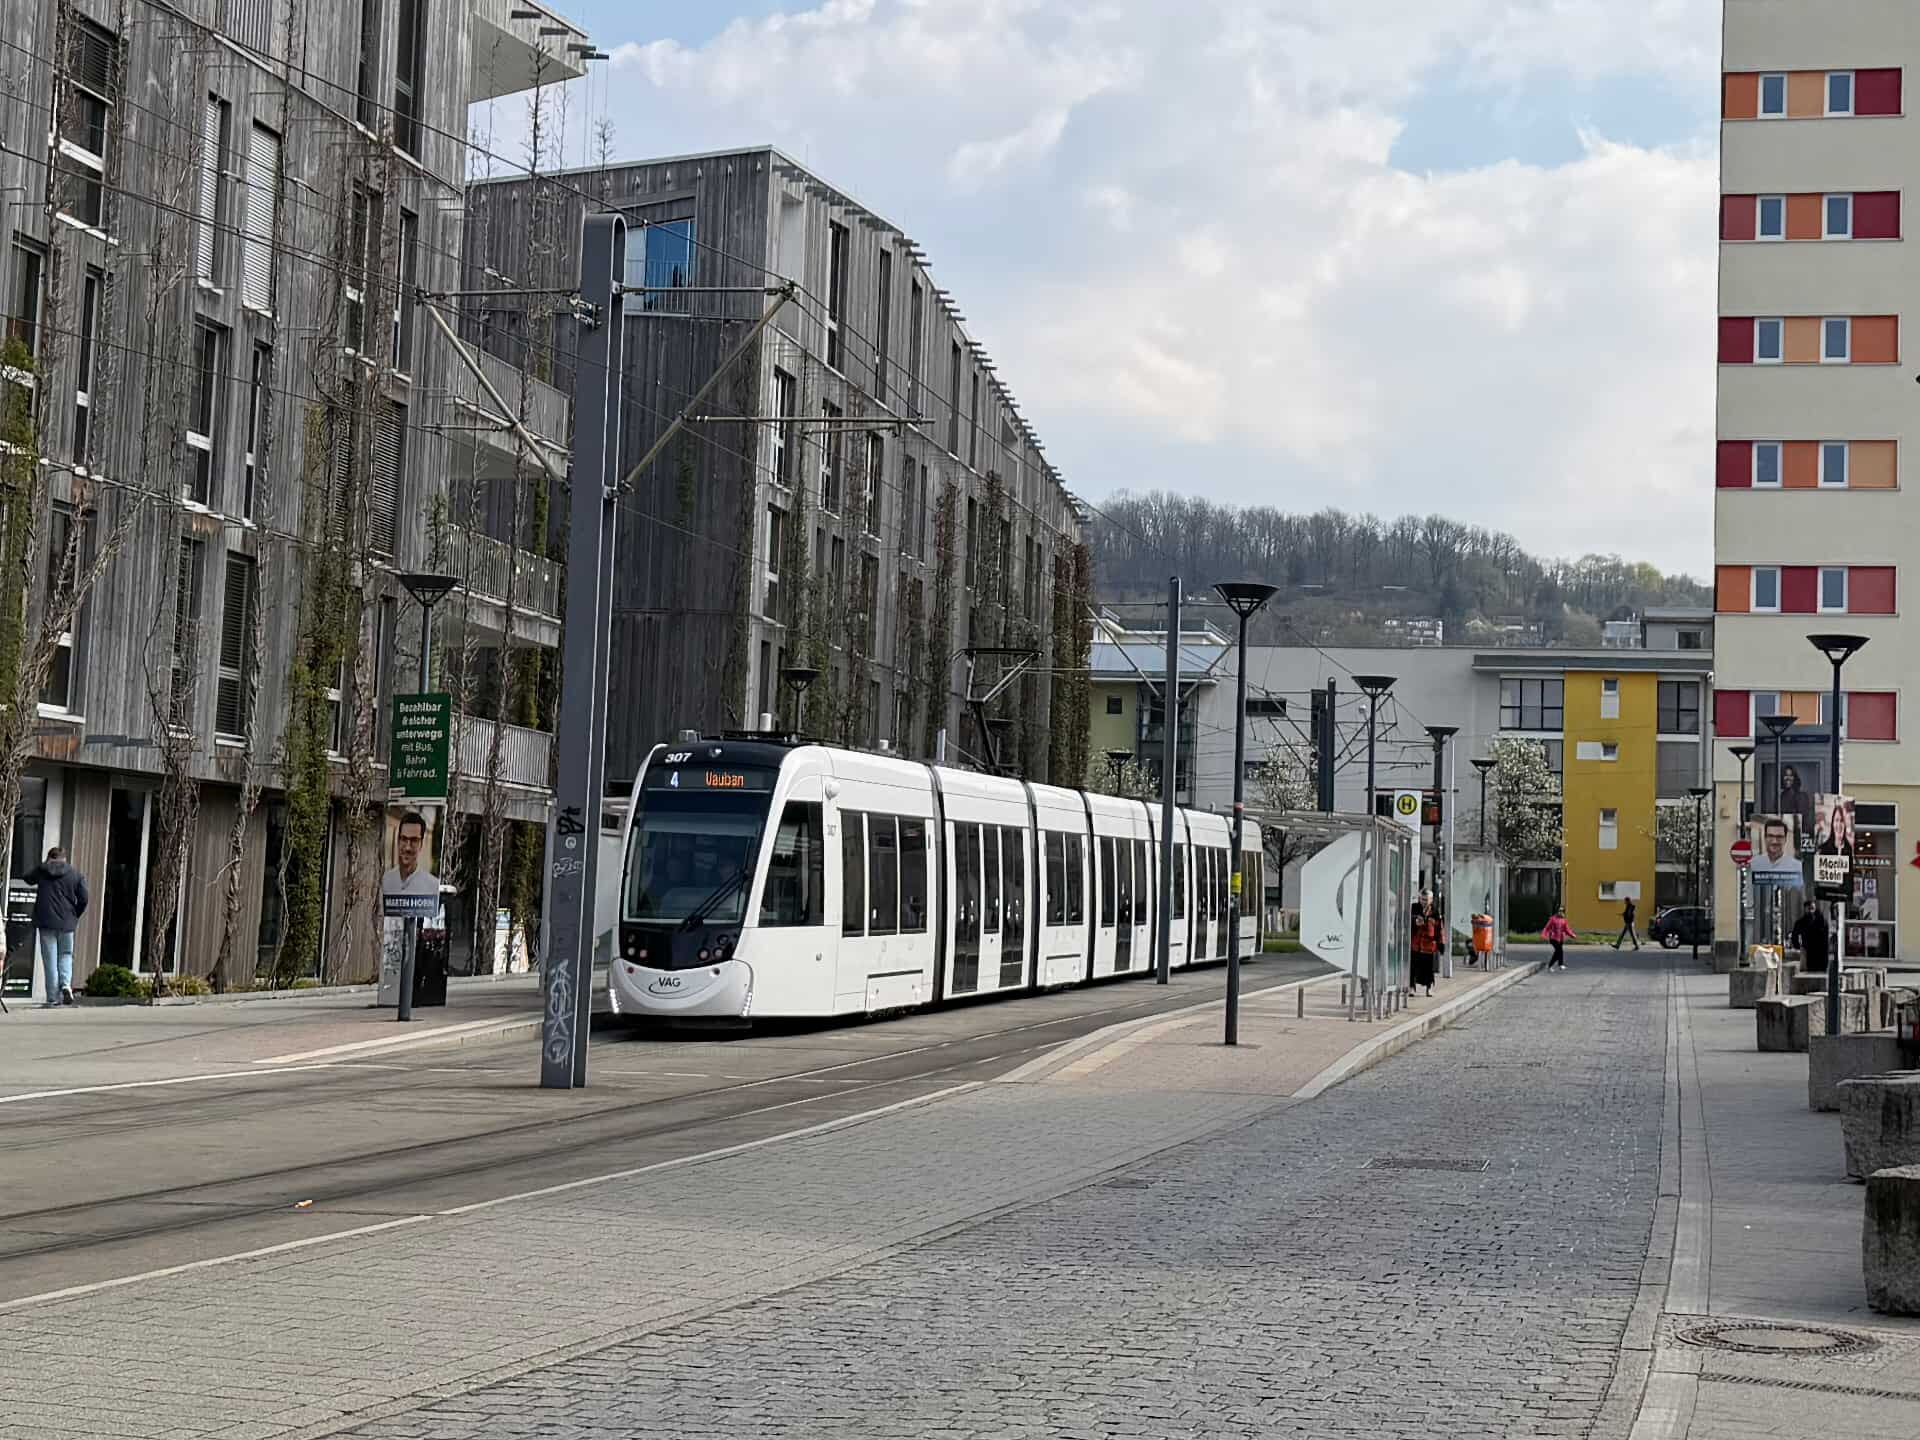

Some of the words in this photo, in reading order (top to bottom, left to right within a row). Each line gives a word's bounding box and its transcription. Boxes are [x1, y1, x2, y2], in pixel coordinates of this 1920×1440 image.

[399, 702, 442, 713] Bezahlbar
[396, 729, 443, 740] unterwegs
[401, 743, 414, 751] mit
[405, 755, 427, 765] Bahn
[665, 752, 692, 763] 307
[670, 771, 679, 787] 4
[705, 772, 744, 787] Vauban
[1818, 857, 1848, 869] Monika
[1818, 870, 1842, 881] Stein
[658, 977, 681, 988] VAG
